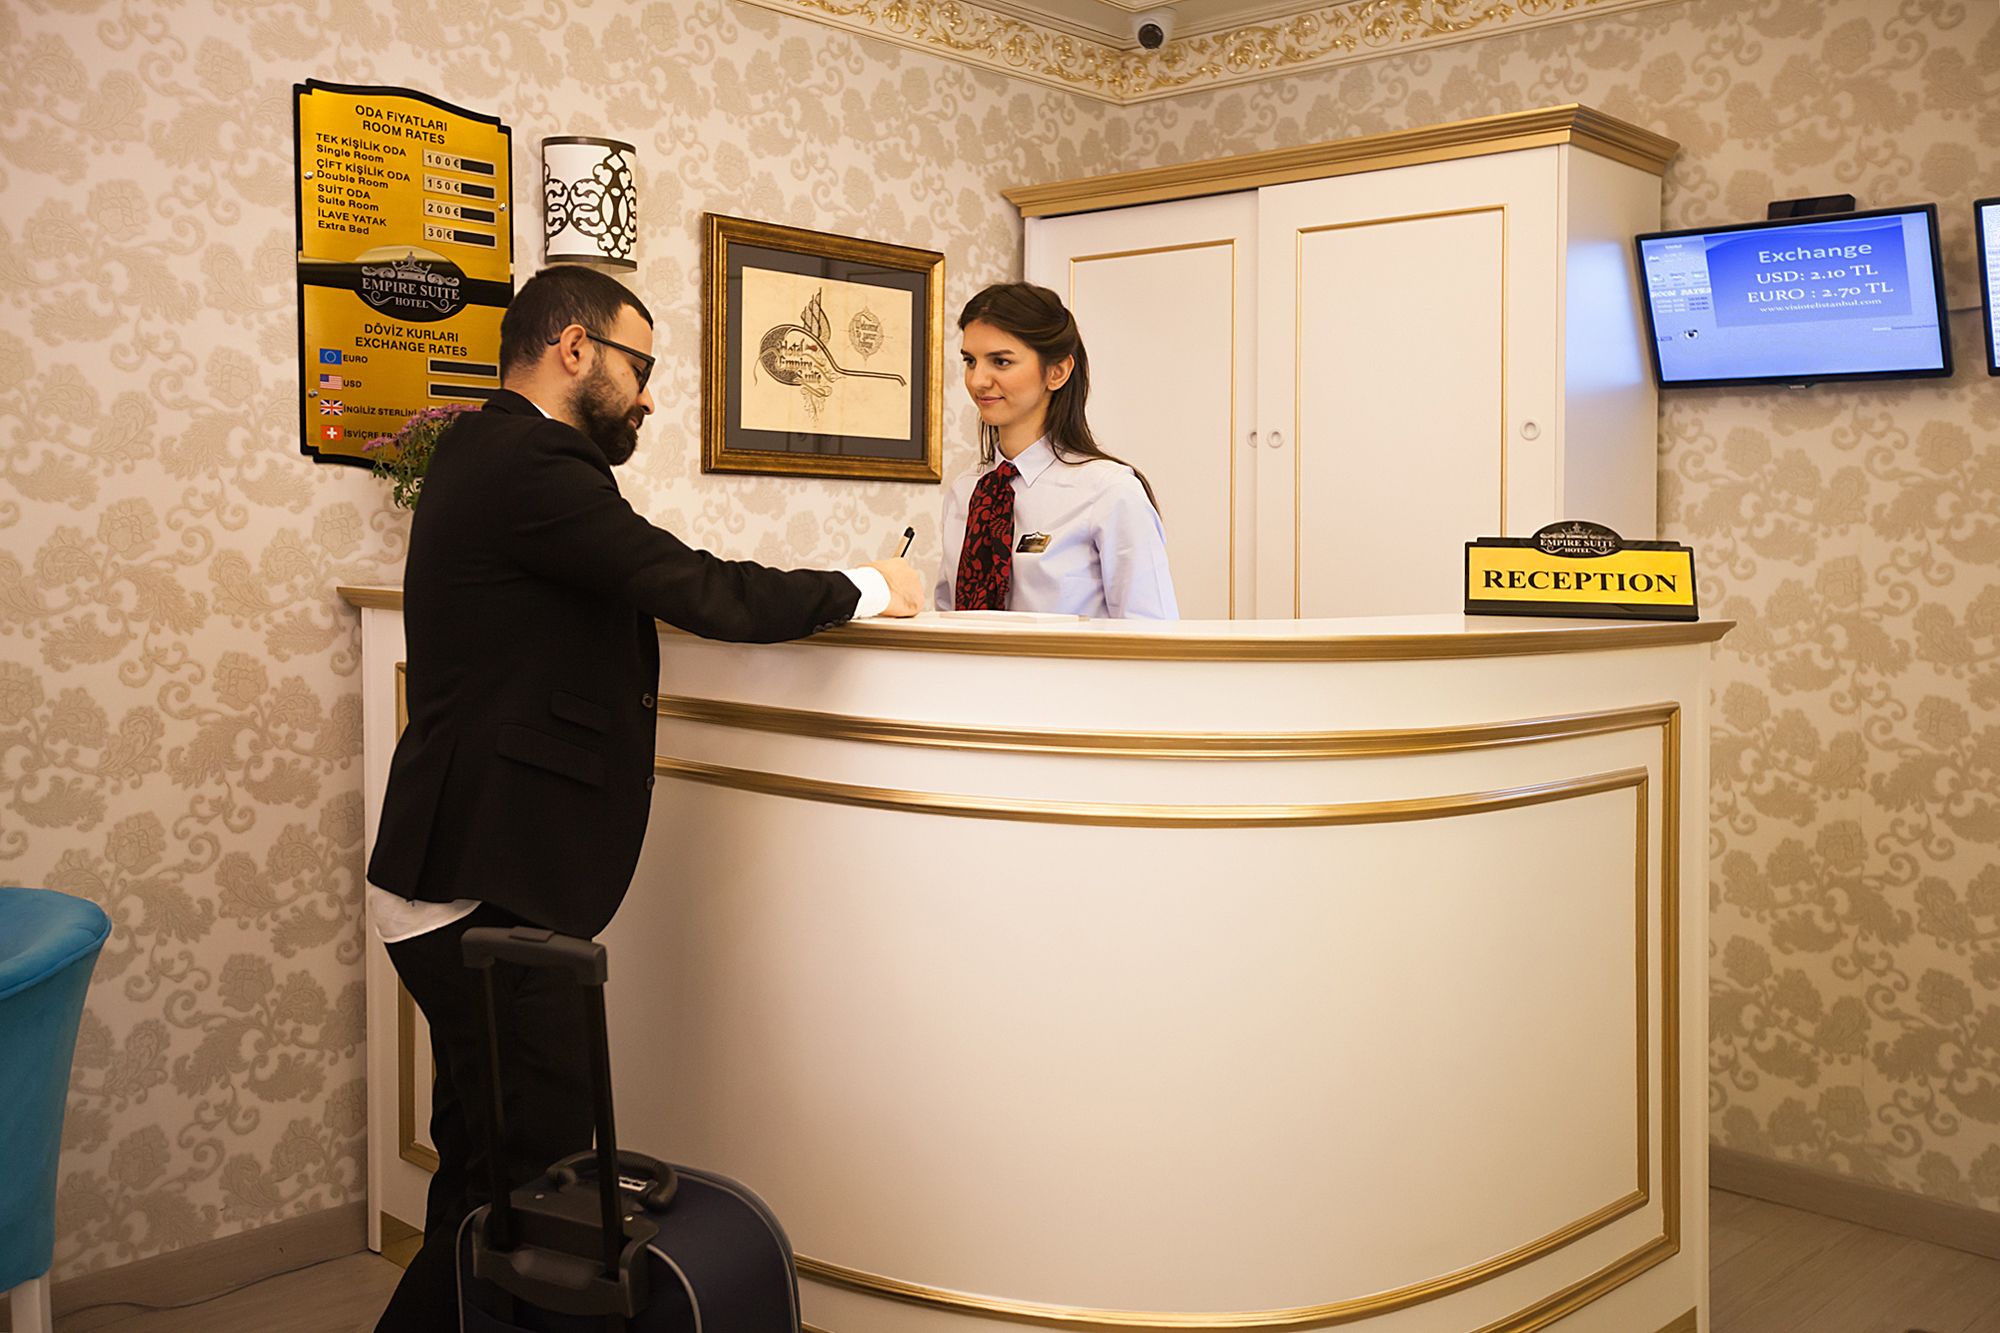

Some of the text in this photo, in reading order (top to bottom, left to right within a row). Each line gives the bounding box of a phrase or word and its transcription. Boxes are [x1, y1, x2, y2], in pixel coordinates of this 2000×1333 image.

[355, 104, 383, 120] ODA
[362, 120, 445, 145] ROOM RATES
[316, 132, 407, 157] TEK KİŞİLİK ODA
[316, 144, 385, 164] Single Room
[316, 158, 411, 182] ÇİFT KİŞİLİK ODA
[316, 169, 389, 190] Double Room
[317, 194, 380, 212] Suite Room
[346, 188, 372, 200] ODA
[317, 220, 370, 236] Extra Bed
[352, 213, 388, 227] YATAK
[1758, 243, 1873, 264] Exchange
[1756, 264, 1879, 285] USD: 2.10 TL
[361, 277, 461, 300] EMPIRE SUITE
[1747, 288, 1806, 303] EURO
[1822, 286, 1861, 299] 2.70
[1864, 281, 1894, 294] TL
[395, 297, 429, 309] HOTEL
[406, 328, 459, 343] KURLARI
[355, 337, 468, 357] EXCHANGE RATES
[343, 354, 369, 364] EURO
[343, 379, 362, 389] USD
[1540, 539, 1616, 548] EMPIRE SUITE
[1482, 569, 1677, 594] RECEPTION
